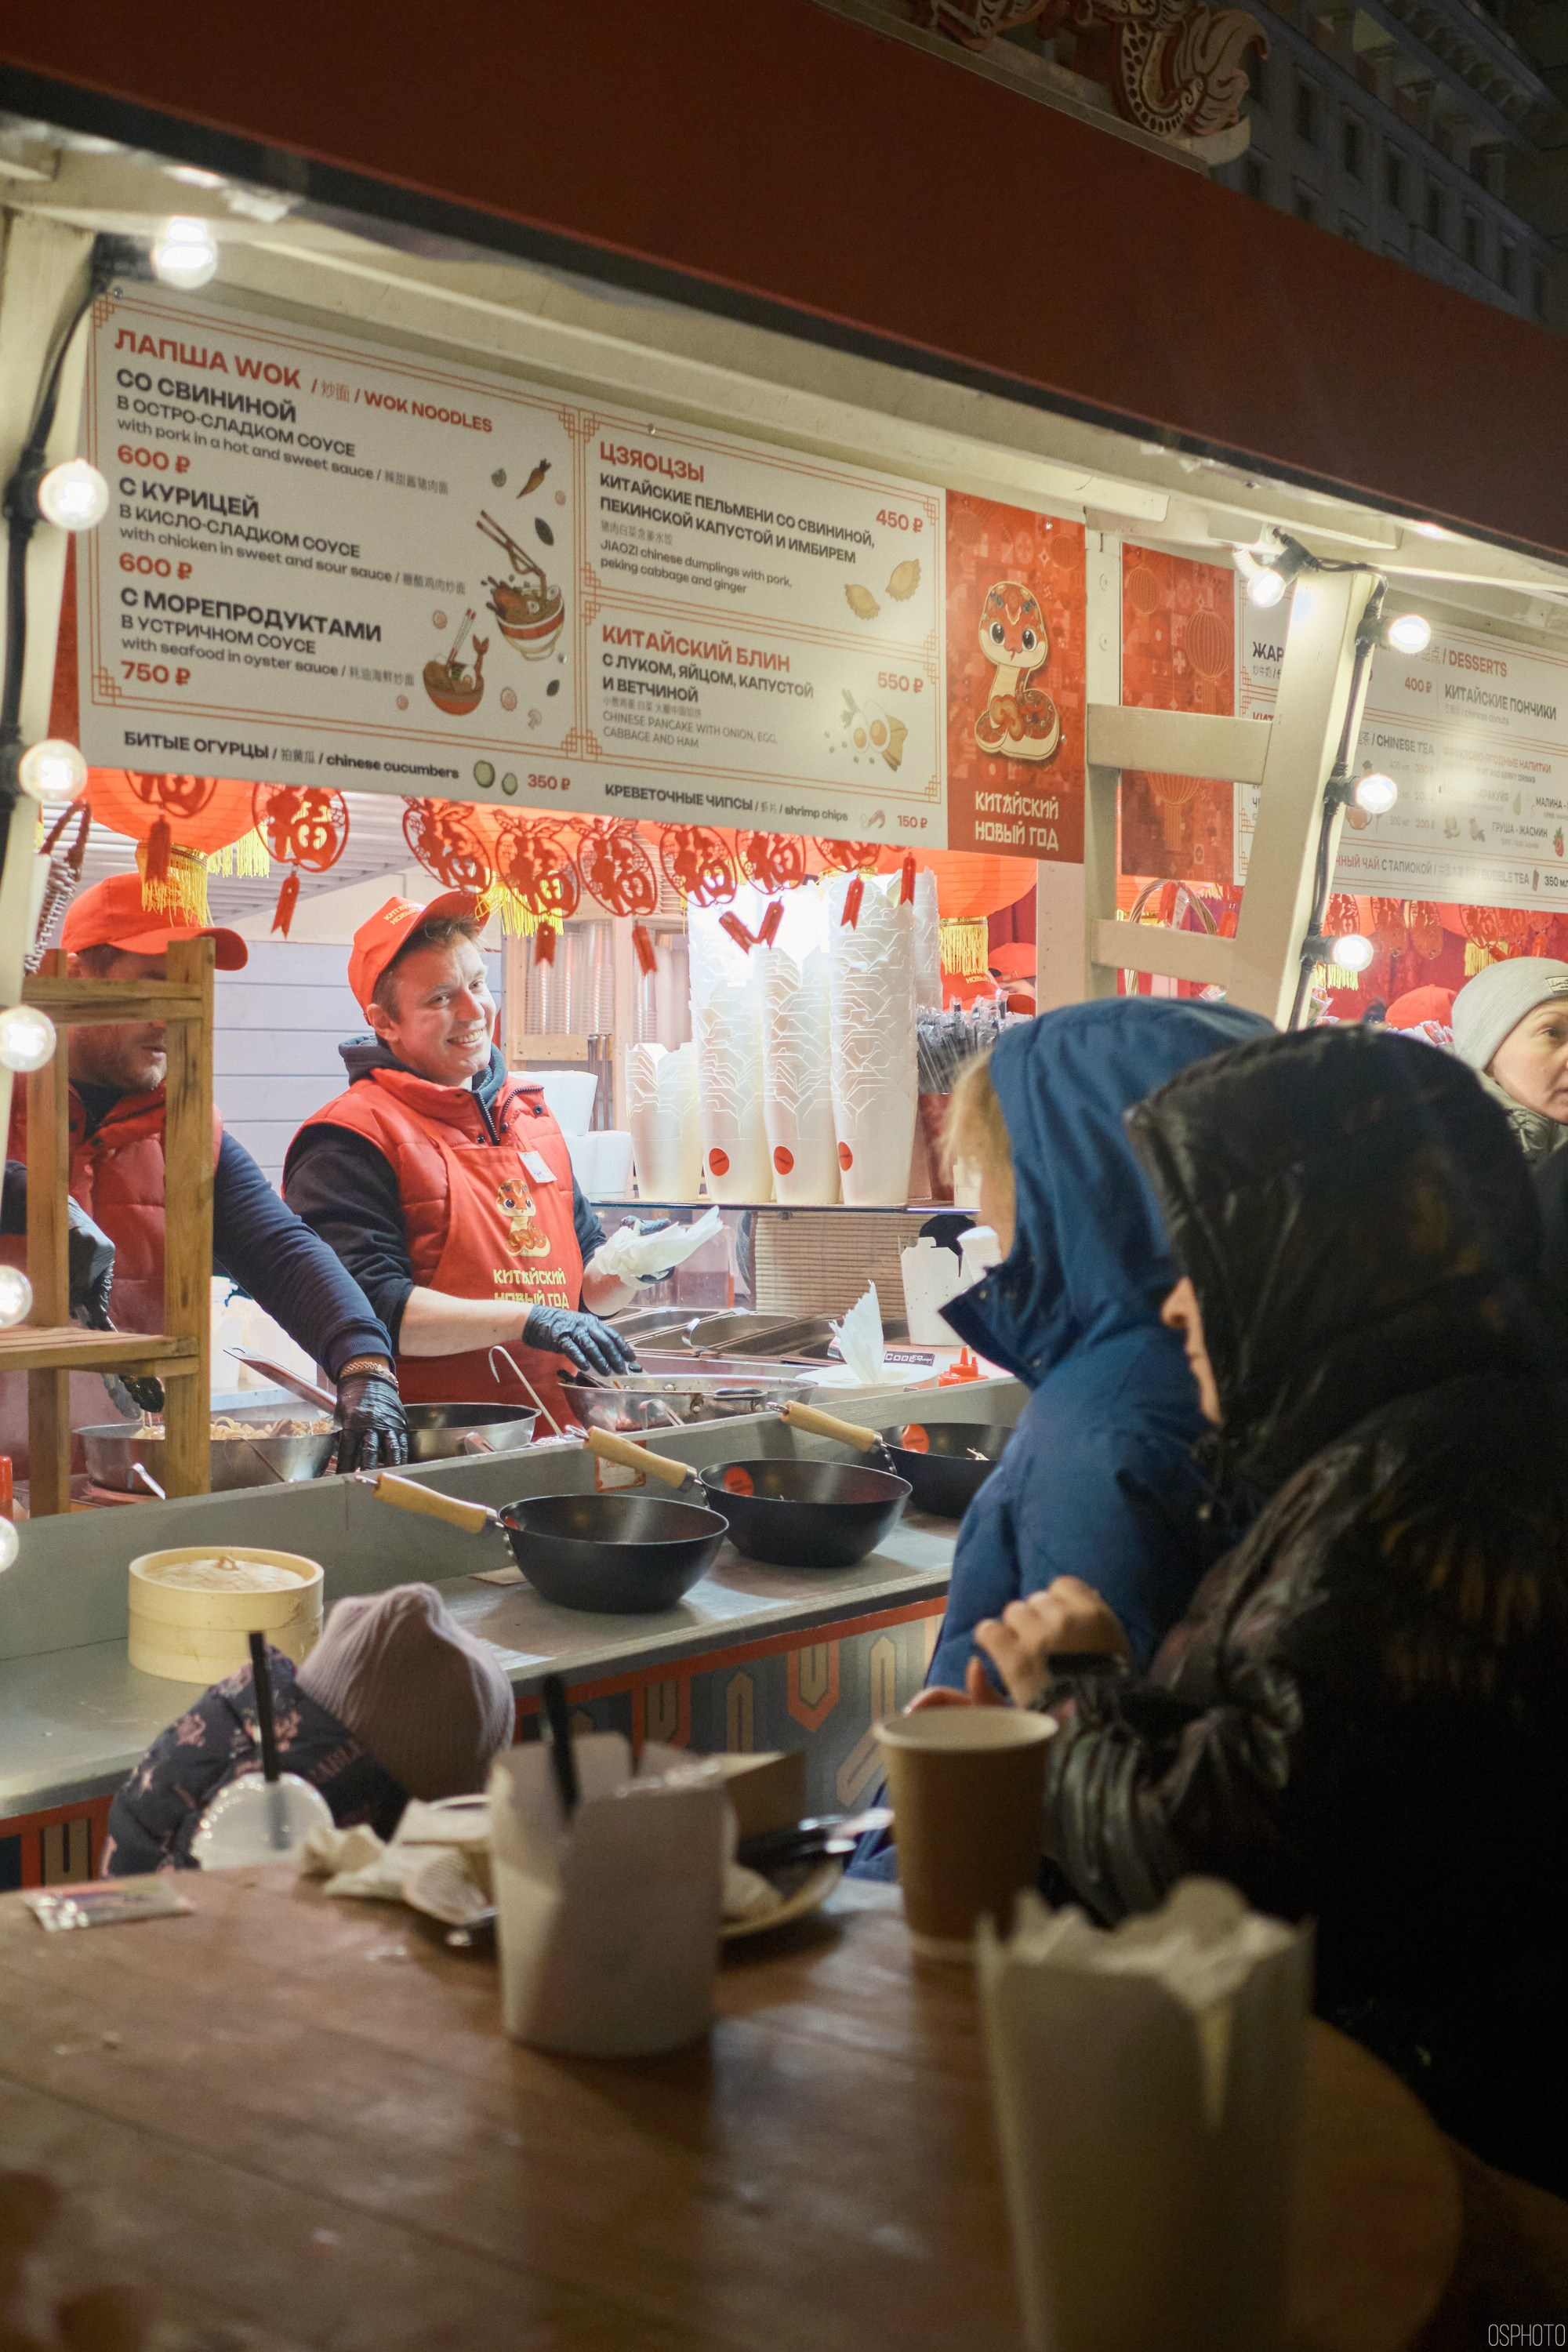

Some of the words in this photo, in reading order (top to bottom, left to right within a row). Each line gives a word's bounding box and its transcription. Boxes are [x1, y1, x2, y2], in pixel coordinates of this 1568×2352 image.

[114, 328, 230, 375] ЛАПША
[233, 354, 302, 390] WOK
[363, 389, 409, 415] WOK
[410, 400, 494, 434] NOODLES
[115, 367, 154, 394] СО
[156, 376, 297, 424] СВИНИНОЙ
[116, 394, 130, 412] В
[132, 397, 295, 445] ОСТРО-СЛАДКОМ
[296, 432, 356, 459] СОУСЕ
[116, 443, 171, 472] 600
[117, 418, 153, 436] with
[154, 426, 191, 444] pork
[193, 430, 209, 447] in
[209, 437, 221, 450] a
[222, 437, 250, 456] hot
[251, 445, 281, 463] and
[282, 452, 329, 472] sweet
[330, 461, 375, 481] sauce
[599, 441, 705, 484] ЦЗЯОЦЗЫ
[118, 476, 137, 498] С
[141, 480, 260, 520] КУРИЦЕЙ
[599, 472, 693, 506] КИТАЙСКИЕ
[694, 493, 775, 525] ПЕЛЬМЕНИ
[775, 512, 797, 530] СО
[797, 517, 876, 550] СВИНИНОЙ,
[118, 503, 132, 520] В
[135, 506, 300, 549] КИСЛО-СЛАДКОМ
[301, 535, 361, 560] СОУСЕ
[599, 495, 694, 530] ПЕКИНСКОЙ
[695, 517, 775, 547] КАПУСТОЙ
[775, 534, 787, 550] И
[787, 536, 857, 564] ИМБИРЕМ
[875, 508, 910, 532] 450
[118, 526, 156, 543] with
[157, 532, 219, 554] chicken
[219, 540, 234, 557] in
[235, 546, 283, 565] sweet
[284, 554, 314, 570] and
[314, 560, 349, 575] sour
[349, 565, 394, 583] sauce
[118, 551, 172, 579] 600
[599, 538, 639, 557] JIAOZI
[639, 547, 684, 566] chinese
[683, 555, 741, 579] dumplings
[741, 568, 766, 583] with
[765, 573, 793, 589] pork,
[599, 557, 640, 576] peking
[639, 564, 691, 585] cabbage
[690, 574, 713, 588] and
[713, 578, 748, 595] ginger
[119, 586, 139, 608] С
[143, 589, 383, 644] МОРЕПРОДУКТАМИ
[120, 612, 135, 630] В
[136, 615, 254, 646] УСТРИЧНОМ
[256, 633, 317, 655] СОУСЕ
[601, 623, 733, 664] КИТАЙСКИЙ
[735, 646, 791, 673] БЛИН
[120, 659, 171, 685] 750
[121, 636, 158, 652] with
[159, 642, 226, 662] seafood
[227, 648, 242, 664] in
[242, 653, 293, 670] oyster
[293, 660, 339, 677] sauce
[1449, 648, 1508, 678] DESSERTS
[601, 652, 615, 668] С
[615, 654, 677, 680] ЛУКОМ,
[677, 662, 738, 689] ЯЙЦОМ,
[738, 673, 815, 699] КАПУСТОЙ
[601, 675, 615, 691] И
[616, 677, 699, 704] ВЕТЧИНОЙ
[877, 670, 911, 693] 550
[1404, 677, 1425, 693] 400
[1445, 683, 1508, 711] КИТАЙСКИЕ
[1510, 697, 1557, 720] ПОНЧИКИ
[601, 709, 645, 728] CHINESE
[647, 716, 694, 734] PANCAKE
[695, 723, 722, 737] WITH
[602, 725, 651, 743] CABBAGE
[652, 732, 676, 746] AND
[676, 735, 700, 749] HAM
[123, 730, 191, 753] БИТЫЕ
[192, 737, 270, 760] ОГУРЦЫ
[325, 753, 383, 771] chinese
[382, 760, 460, 780] cucumbers
[1377, 734, 1416, 753] CHINESE
[1417, 741, 1435, 755] TEA
[527, 772, 559, 791] 350
[1519, 760, 1552, 775] НАПИТКИ
[604, 782, 705, 807] КРЕВЕТОЧНЫЕ
[705, 793, 754, 811] ЧИПСЫ
[783, 804, 821, 820] shrimp
[821, 808, 849, 823] chips
[975, 790, 1058, 820] КИТАЙСКИЙ
[1536, 796, 1563, 810] МАЛИНА
[896, 814, 919, 829] 150
[975, 820, 1025, 845] НОВЫЙ
[1029, 826, 1058, 851] ГОД
[1492, 821, 1515, 834] ГРУША
[1519, 826, 1548, 839] ЖАСМИН
[1362, 855, 1380, 870] ЧАЙ
[1381, 858, 1387, 871] С
[1388, 858, 1432, 875] ТАПИОКОЙ
[1482, 868, 1513, 883] BUBBLE
[1514, 872, 1530, 885] TEA
[1544, 876, 1559, 887] 350
[493, 1267, 567, 1285] КИТАЙСКИЙ
[548, 1292, 570, 1309] ГОД
